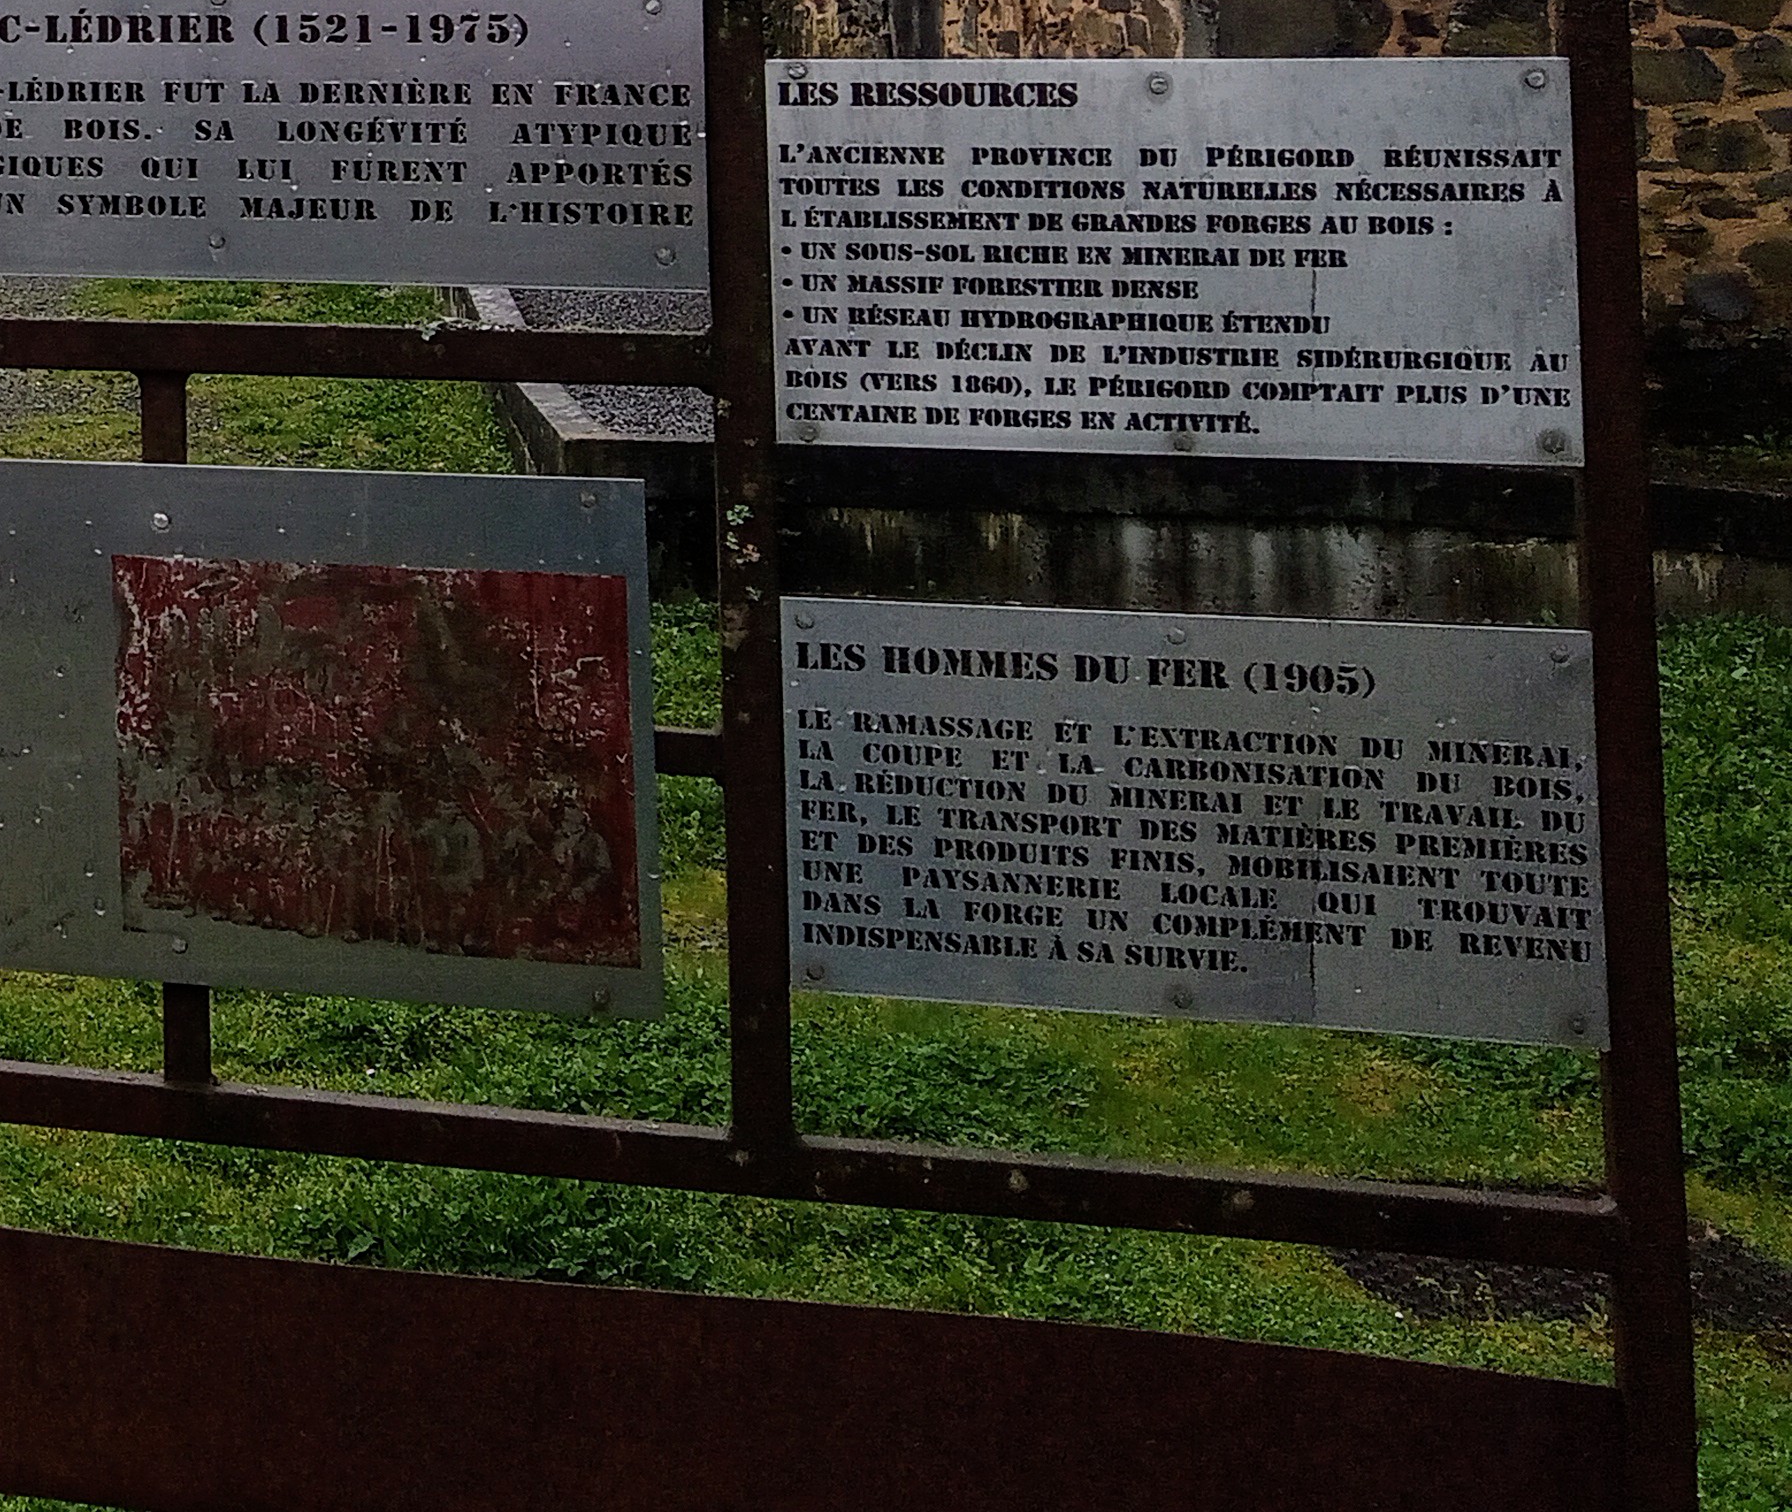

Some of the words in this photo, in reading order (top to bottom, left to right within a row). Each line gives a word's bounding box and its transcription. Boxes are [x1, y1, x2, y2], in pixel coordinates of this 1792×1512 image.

[252, 11, 531, 47] (1521-1975)
[162, 81, 225, 104] FUT
[241, 81, 281, 105] LA
[297, 77, 472, 106] DERNIÈRE
[490, 82, 534, 106] EN
[552, 82, 691, 107] FRANCE
[776, 81, 840, 107] LES
[848, 81, 1079, 108] RESSOURCES
[63, 118, 152, 141] BOIS.
[193, 119, 235, 142] SA
[276, 115, 467, 144] LONGÉVITÉ
[139, 156, 198, 180] QUI
[236, 157, 292, 181] LUI
[330, 158, 468, 183] FURENT
[505, 156, 693, 186] APPORTÉS
[778, 144, 946, 166] L'ANCIENNE
[969, 145, 1113, 167] PROVINCE
[1137, 146, 1178, 167] DU
[1204, 142, 1355, 168] PÉRIGORD
[1382, 142, 1563, 170] RÉUNISSAIT
[777, 176, 880, 197] TOUTES
[895, 177, 944, 198] LES
[959, 178, 1126, 200] CONDITIONS
[1140, 179, 1318, 201] NATURELLES
[1333, 177, 1526, 203] NÉCESSAIRES
[1539, 178, 1563, 204] À
[55, 193, 207, 218] SYMBOLE
[237, 195, 378, 221] MAJEUR
[408, 198, 454, 222] DE
[1026, 211, 1064, 232] DE
[1069, 212, 1197, 233] GRANDES
[1204, 213, 1312, 235] FORGES
[1318, 214, 1360, 235] AU
[1366, 215, 1435, 236] BOIS
[799, 241, 837, 261] UN
[844, 242, 976, 263] SOUS-SOL
[981, 243, 1069, 265] RICHE
[1075, 245, 1113, 265] EN
[1120, 245, 1241, 267] MINERAI
[1247, 247, 1286, 268] DE
[1292, 247, 1349, 269] FER
[800, 273, 838, 294] UN
[845, 274, 945, 295] MASSIF
[950, 275, 1104, 298] FORESTIER
[1110, 278, 1199, 300] DENSE
[801, 305, 839, 326] UN
[846, 302, 951, 328] RÉSEAU
[958, 308, 1214, 333] HYDROGRAPHIQUE
[1220, 308, 1332, 335] ÉTENDU
[782, 337, 872, 359] AVANT
[885, 339, 920, 360] LE
[934, 336, 1034, 362] DÉCLIN
[1048, 342, 1086, 363] DE
[1101, 343, 1279, 368] L'INDUSTRIE
[1294, 343, 1512, 373] SIDÉRURGIQUE
[1527, 352, 1570, 374] AU
[783, 369, 848, 391] BOIS
[858, 370, 938, 394] (VERS
[950, 373, 1032, 398] 1860),
[1043, 375, 1077, 396] LE
[1087, 372, 1231, 400] PÉRIGORD
[1240, 380, 1385, 404] COMPTAIT
[1393, 383, 1468, 406] PLUS
[1479, 385, 1572, 408] D'UNE
[784, 402, 918, 425] CENTAINE
[923, 405, 961, 426] DE
[967, 406, 1072, 429] FORGES
[1078, 409, 1117, 431] EN
[1122, 406, 1261, 434] ACTIVITÉ.
[794, 640, 867, 673] LES
[880, 644, 1059, 682] HOMMES
[1072, 653, 1132, 685] DU
[1145, 656, 1230, 690] FER
[1241, 659, 1377, 698] (1905)
[796, 708, 832, 732] LE
[851, 710, 1034, 742] RAMASSAGE
[1052, 720, 1093, 745] ET
[1358, 736, 1405, 761] DU
[1426, 739, 1583, 773] MINERAI,
[797, 738, 835, 762] LA
[861, 741, 963, 769] COUPE
[990, 748, 1030, 773] ET
[1057, 751, 1096, 776] LA
[1122, 755, 1385, 791] CARBONISATION
[1415, 770, 1461, 795] DU
[1491, 774, 1584, 805] BOIS,
[798, 768, 835, 793] LA
[852, 767, 1027, 803] RÉDUCTION
[1046, 782, 1088, 806] DU
[1107, 785, 1243, 815] MINERAI
[1261, 793, 1304, 818] ET
[1321, 796, 1360, 821] LE
[1377, 800, 1522, 830] TRAVAIL
[1539, 808, 1587, 834] DU
[799, 798, 868, 828] FER,
[884, 803, 922, 828] LE
[935, 806, 1123, 839] TRANSPORT
[1137, 817, 1197, 844] DES
[799, 829, 839, 853] ET
[856, 832, 914, 858] DES
[932, 836, 1090, 868] PRODUITS
[1109, 847, 1206, 879] FINIS,
[1226, 853, 1461, 890] MOBILISAIENT
[1478, 868, 1590, 898] TOUTE
[801, 859, 863, 885] UNE
[901, 865, 1121, 901] PAYSANNERIE
[1159, 880, 1278, 911] LOCALE
[1317, 889, 1377, 917] QUI
[1416, 896, 1593, 931] TROUVAIT
[801, 889, 882, 917] DANS
[900, 895, 941, 921] LA
[962, 899, 1064, 929] FORGE
[1085, 907, 1129, 933] UN
[1389, 926, 1435, 953] DE
[1457, 930, 1593, 963] REVENU
[801, 922, 1038, 960] INDISPENSABLE
[1045, 933, 1069, 962] À
[1075, 939, 1115, 965] SA
[1122, 942, 1248, 973] SURVIE.
